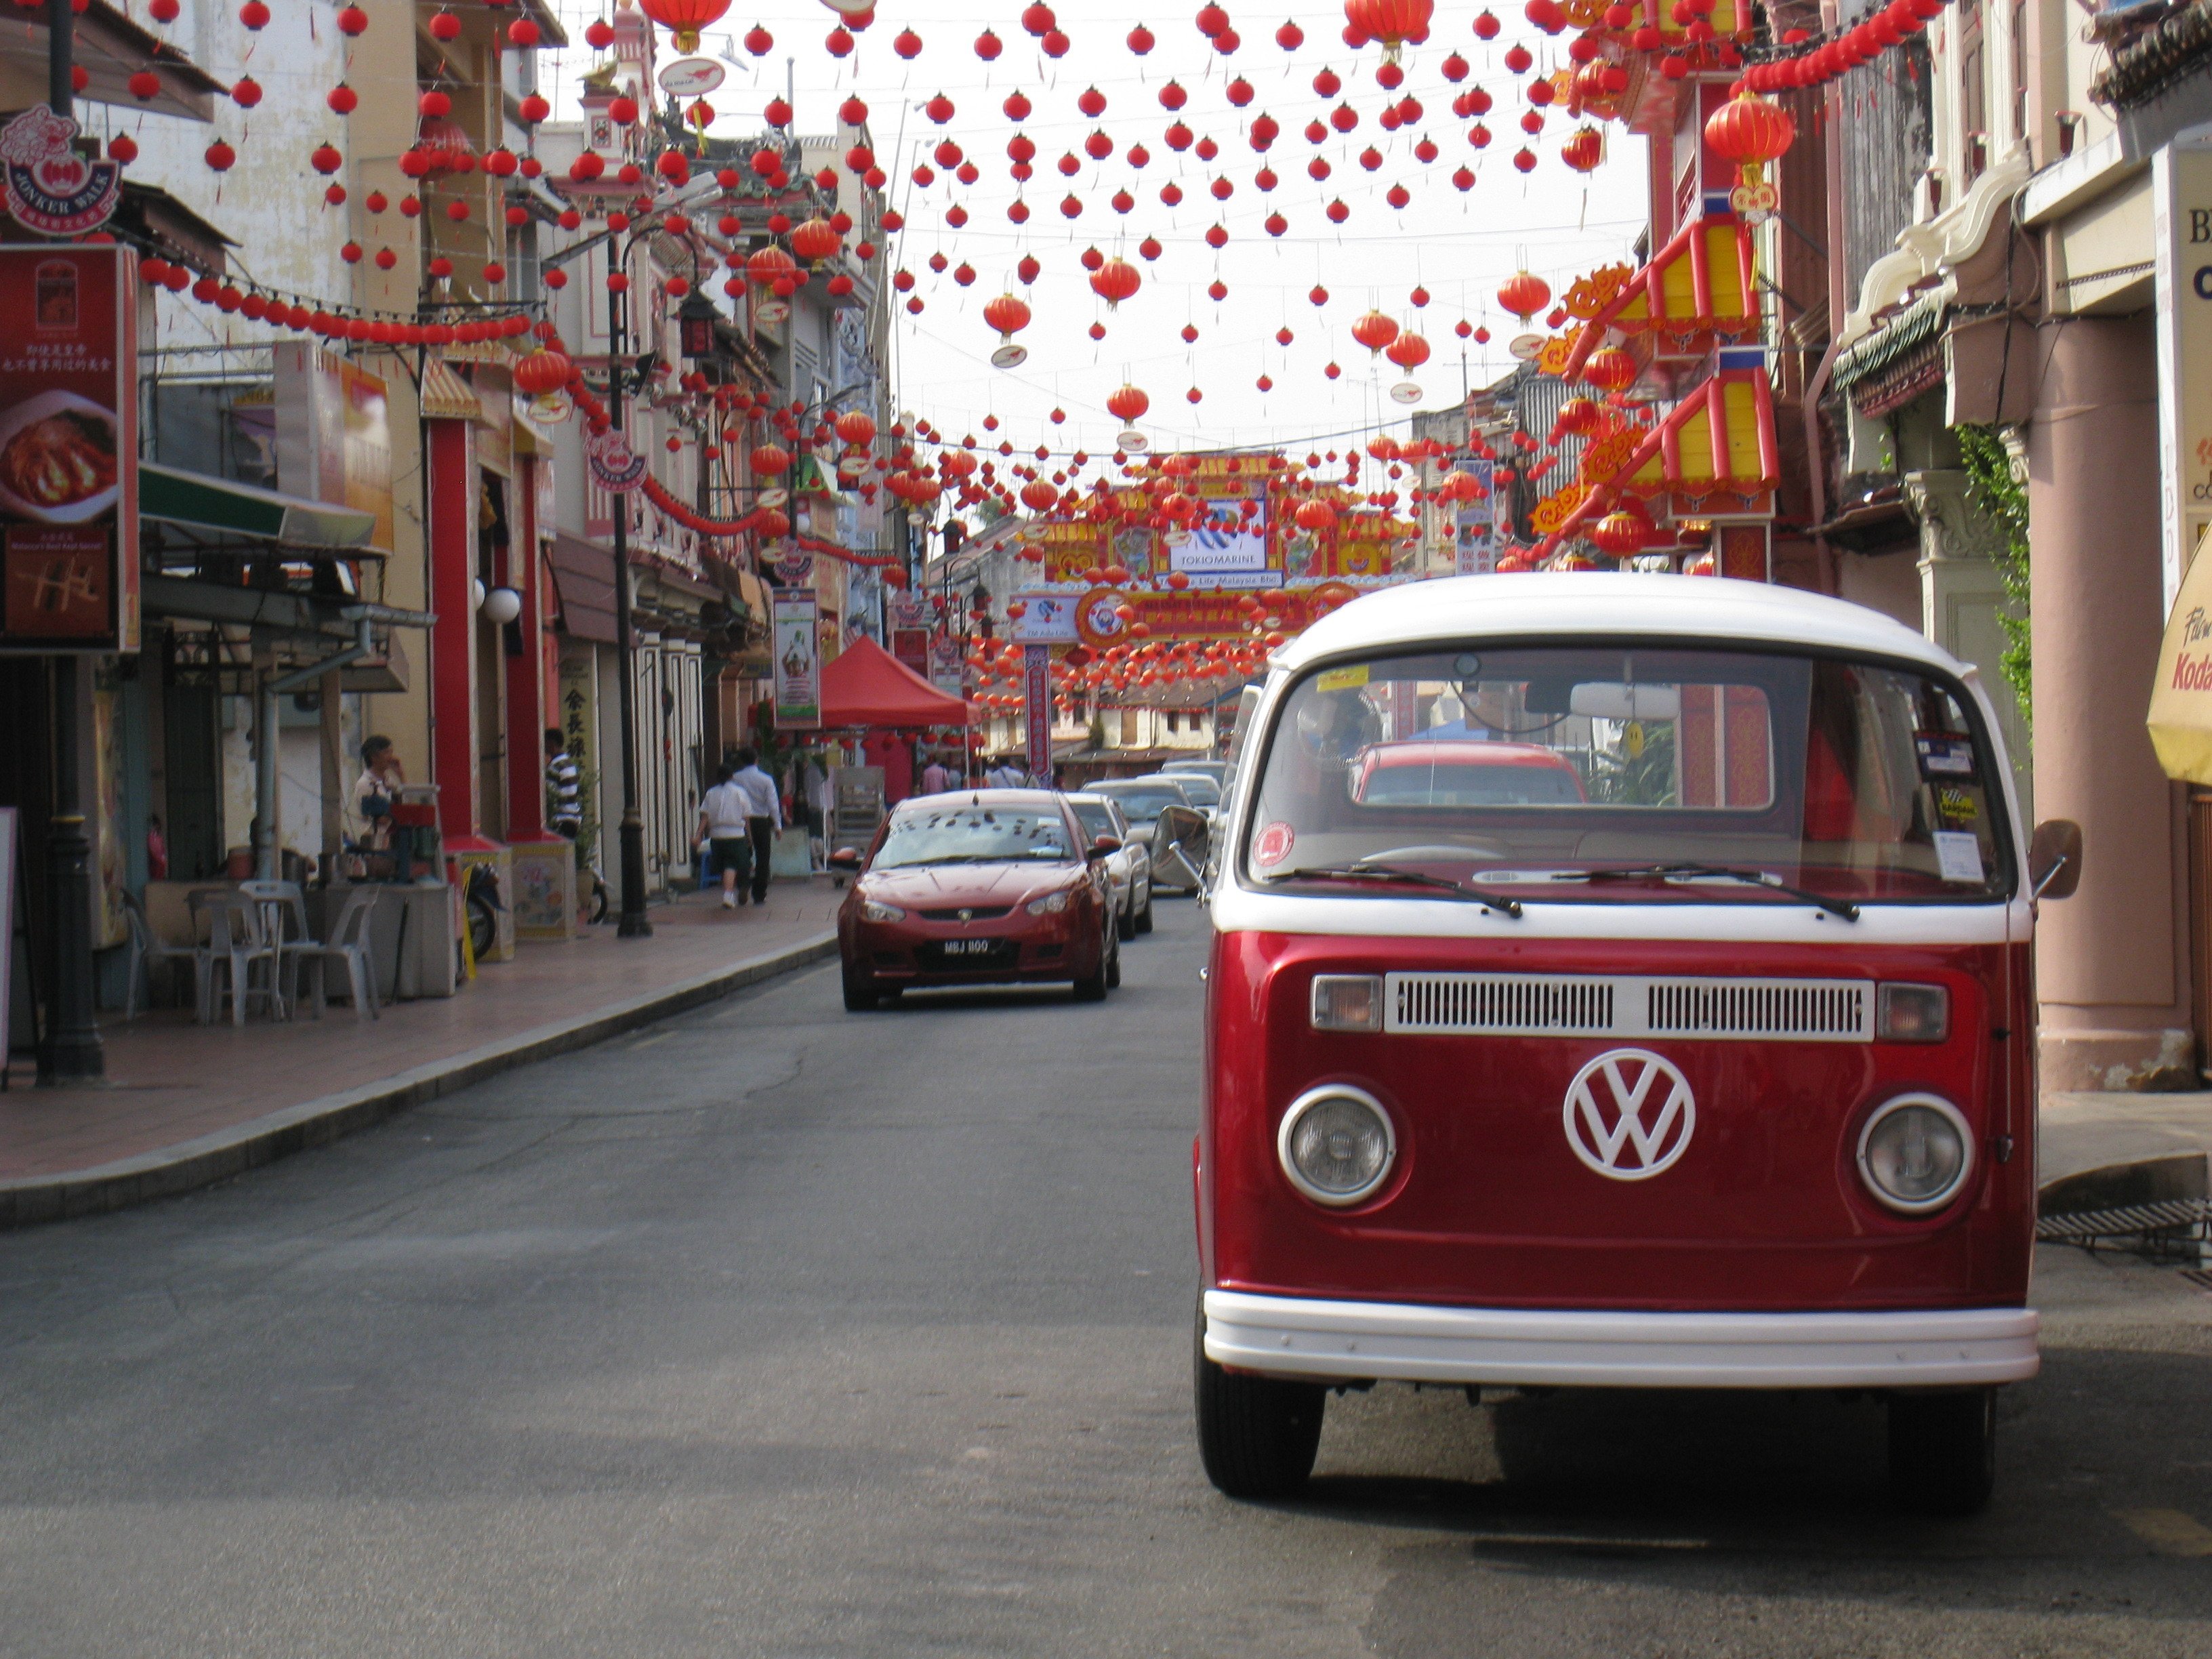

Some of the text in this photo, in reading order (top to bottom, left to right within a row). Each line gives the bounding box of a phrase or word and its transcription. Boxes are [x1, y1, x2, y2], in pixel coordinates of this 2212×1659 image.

[14, 172, 109, 214] JONKER WALK
[2188, 208, 2212, 243] B
[1218, 575, 1256, 587] Malaysia
[944, 940, 966, 955] MBJ
[1570, 1056, 1687, 1171] VW
